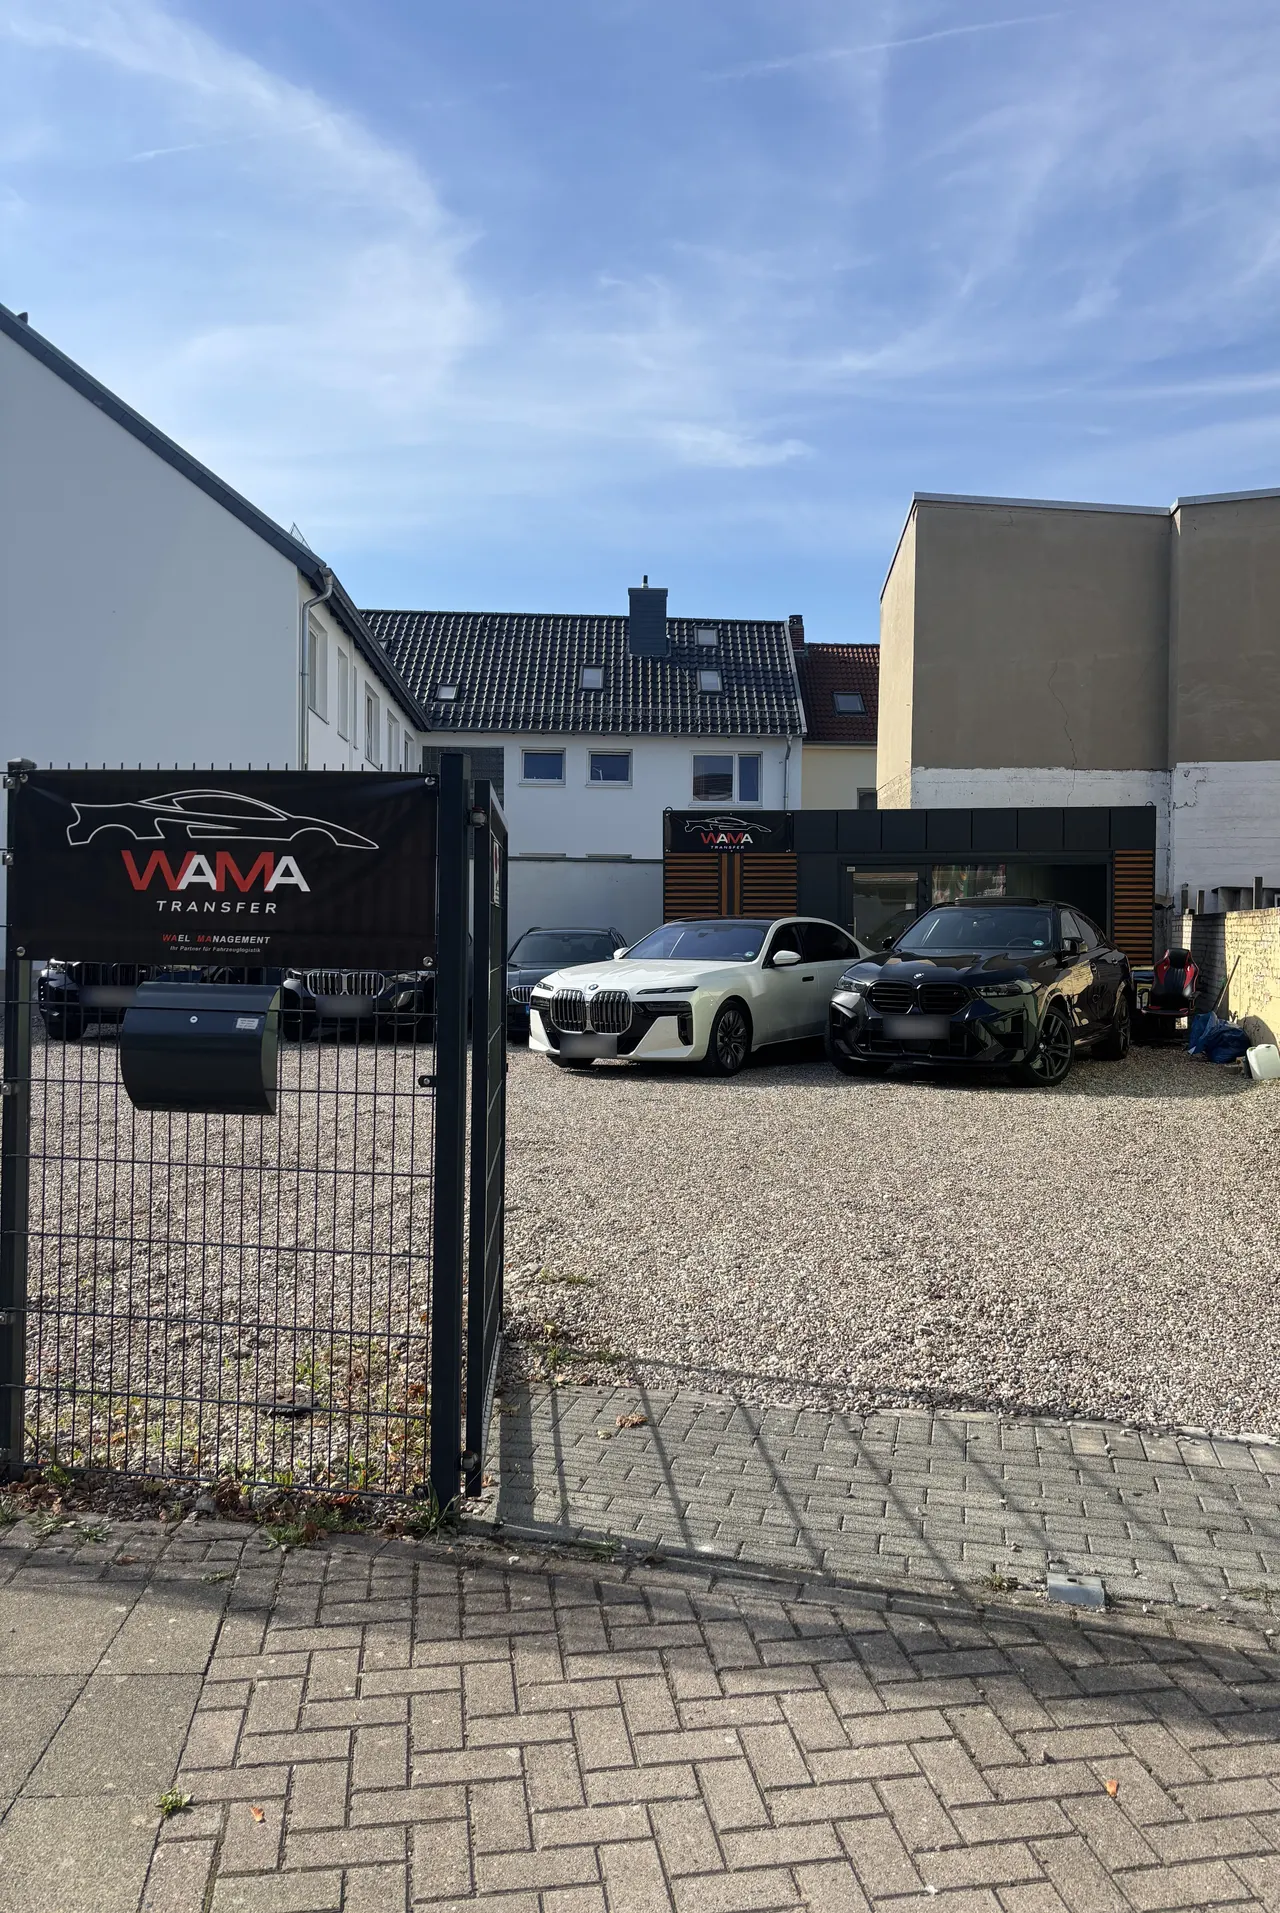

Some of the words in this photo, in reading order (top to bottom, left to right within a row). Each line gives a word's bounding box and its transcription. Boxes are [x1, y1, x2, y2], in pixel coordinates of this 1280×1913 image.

[701, 832, 753, 844] WAMA
[121, 850, 310, 892] WAMA
[156, 900, 277, 913] TRANSFER
[162, 934, 190, 943] WAEL
[197, 935, 270, 944] MANAGEMENT
